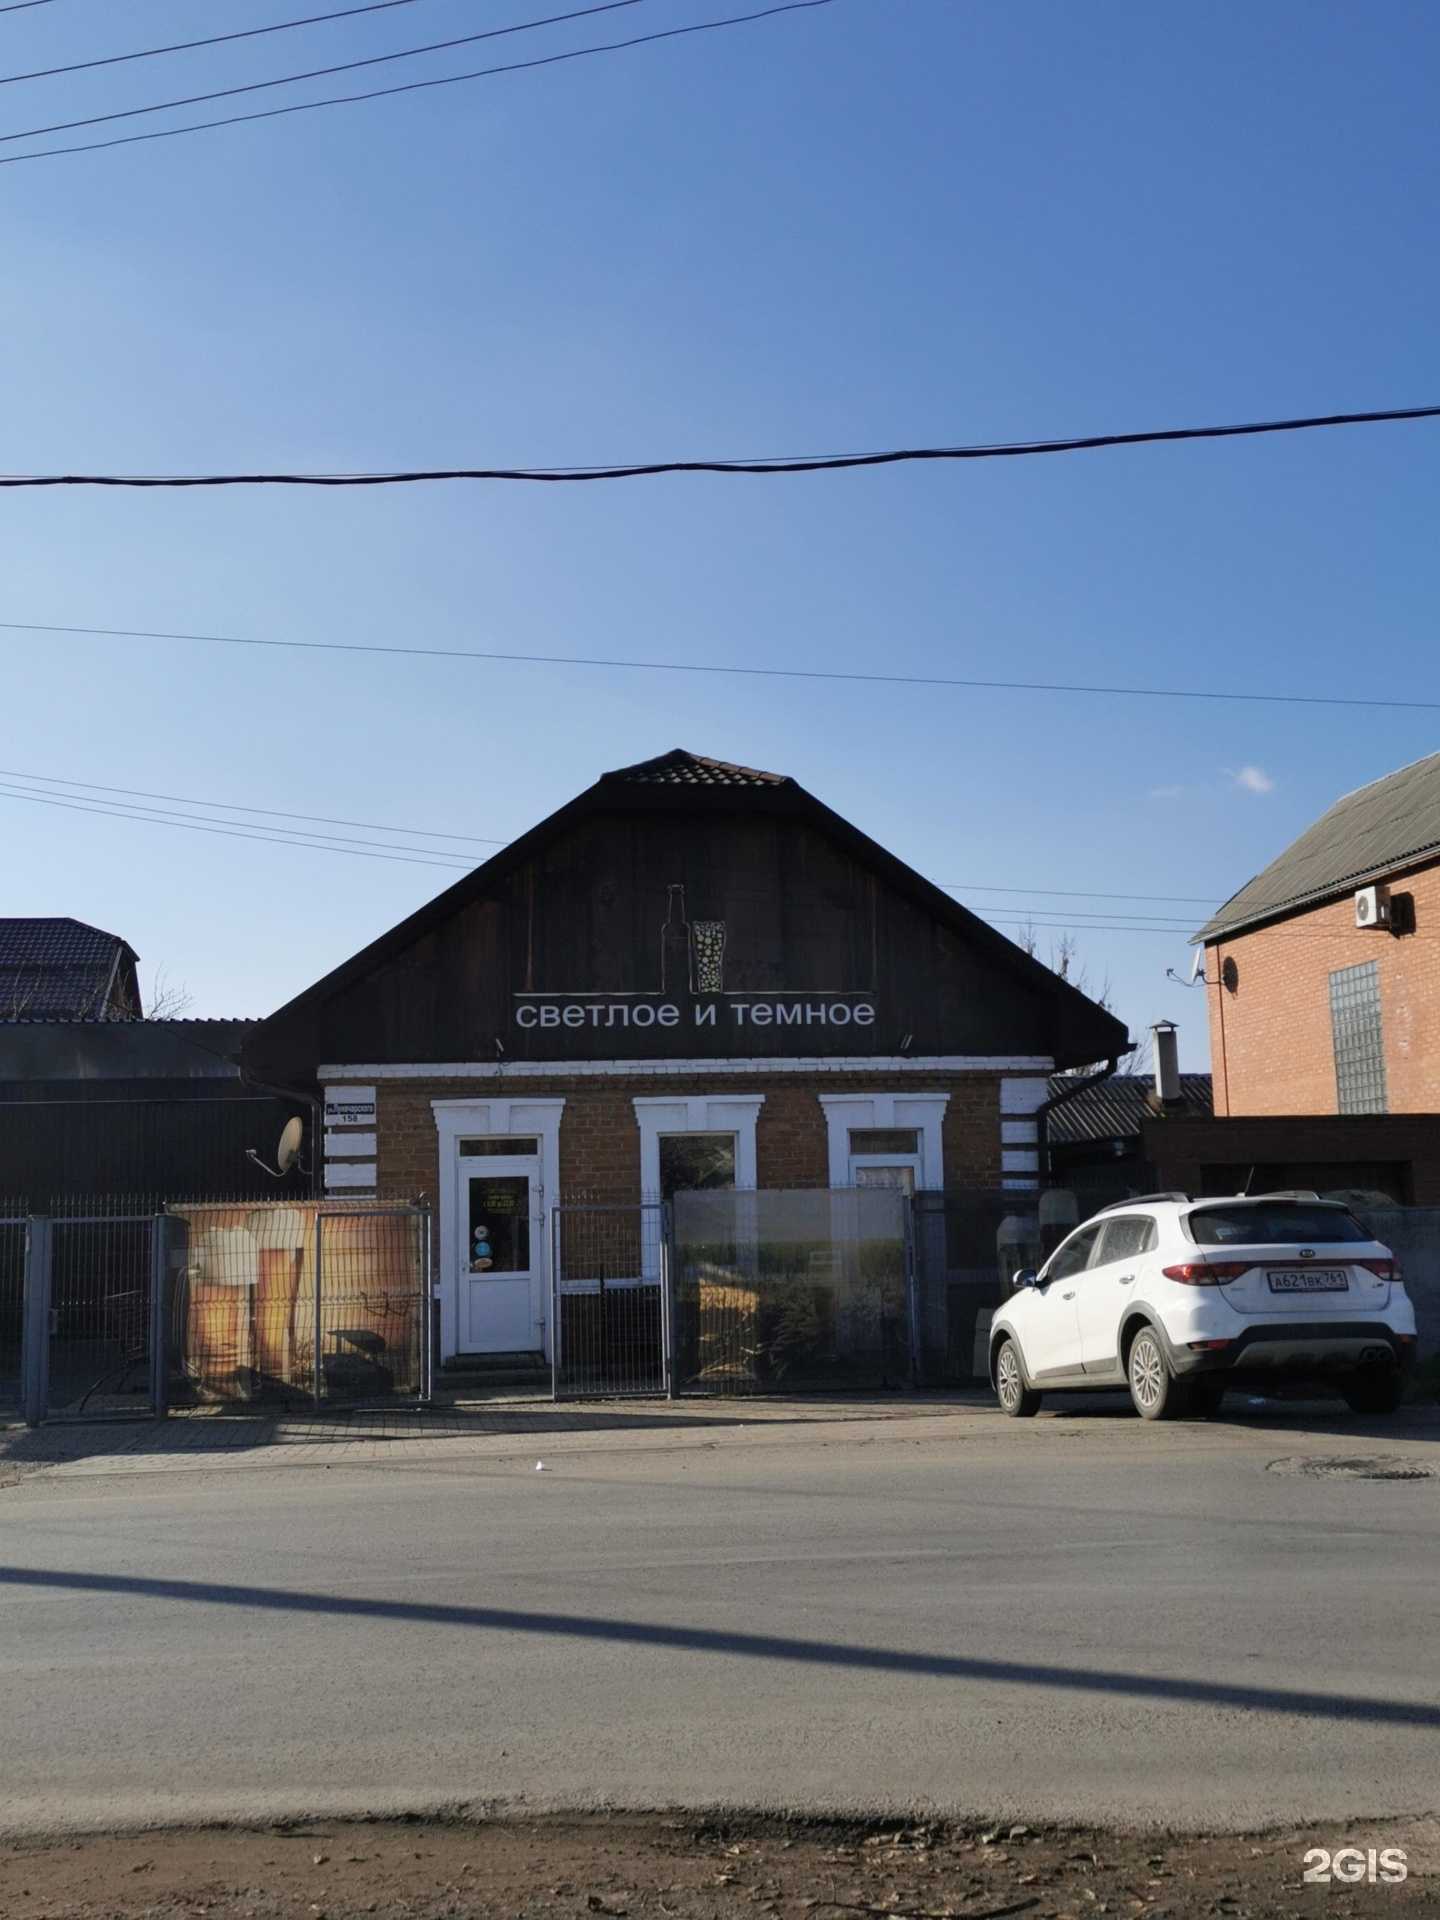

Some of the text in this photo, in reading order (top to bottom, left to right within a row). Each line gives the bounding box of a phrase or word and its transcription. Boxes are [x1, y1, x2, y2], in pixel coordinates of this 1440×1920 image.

[515, 1003, 875, 1028] светлое и темное
